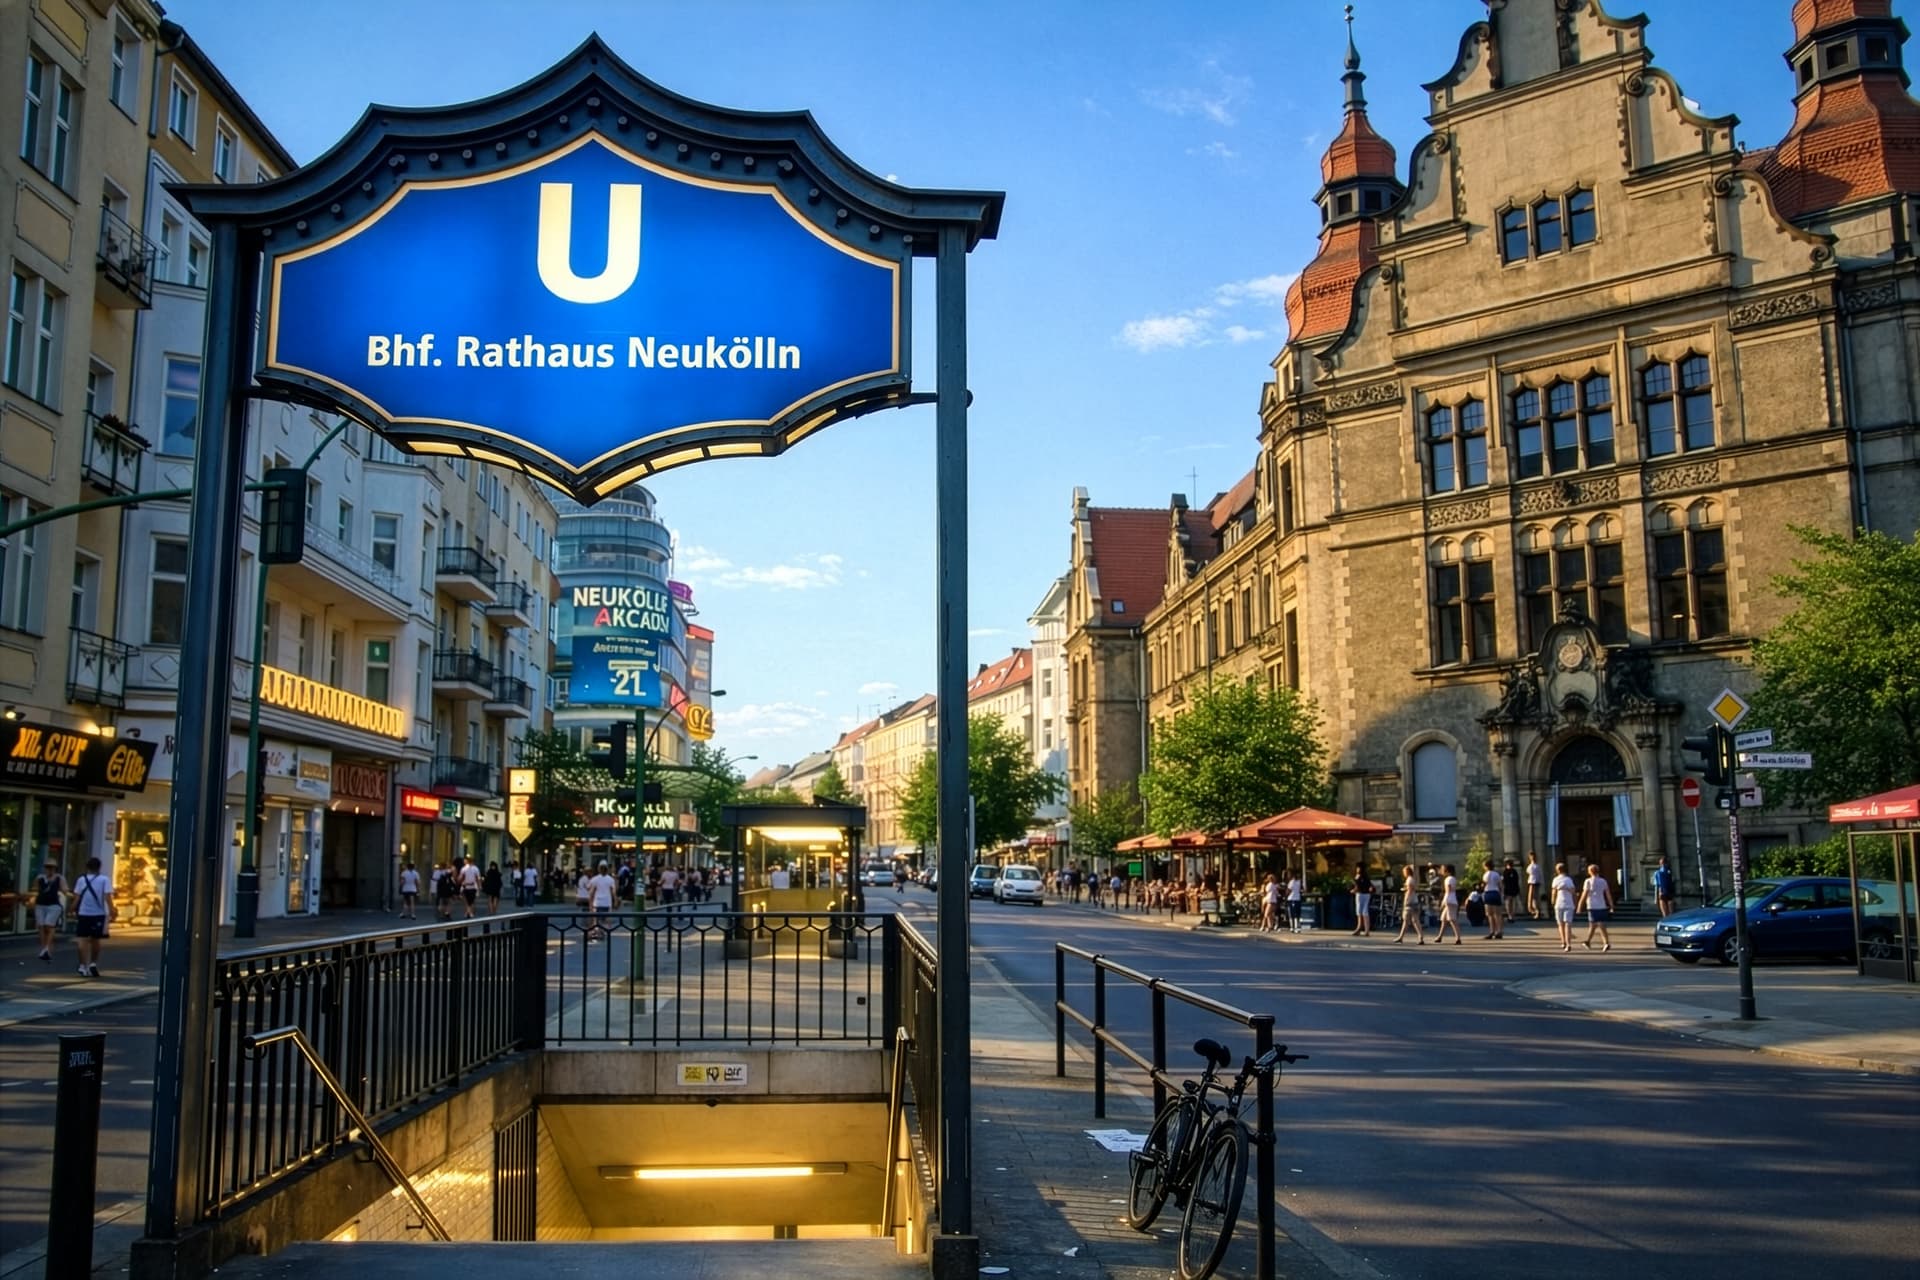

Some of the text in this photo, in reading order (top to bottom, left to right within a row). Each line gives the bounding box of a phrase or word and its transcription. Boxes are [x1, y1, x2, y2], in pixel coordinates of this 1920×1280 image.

[537, 182, 642, 305] U
[367, 334, 801, 369] Bhf. Rathaus Neukölln
